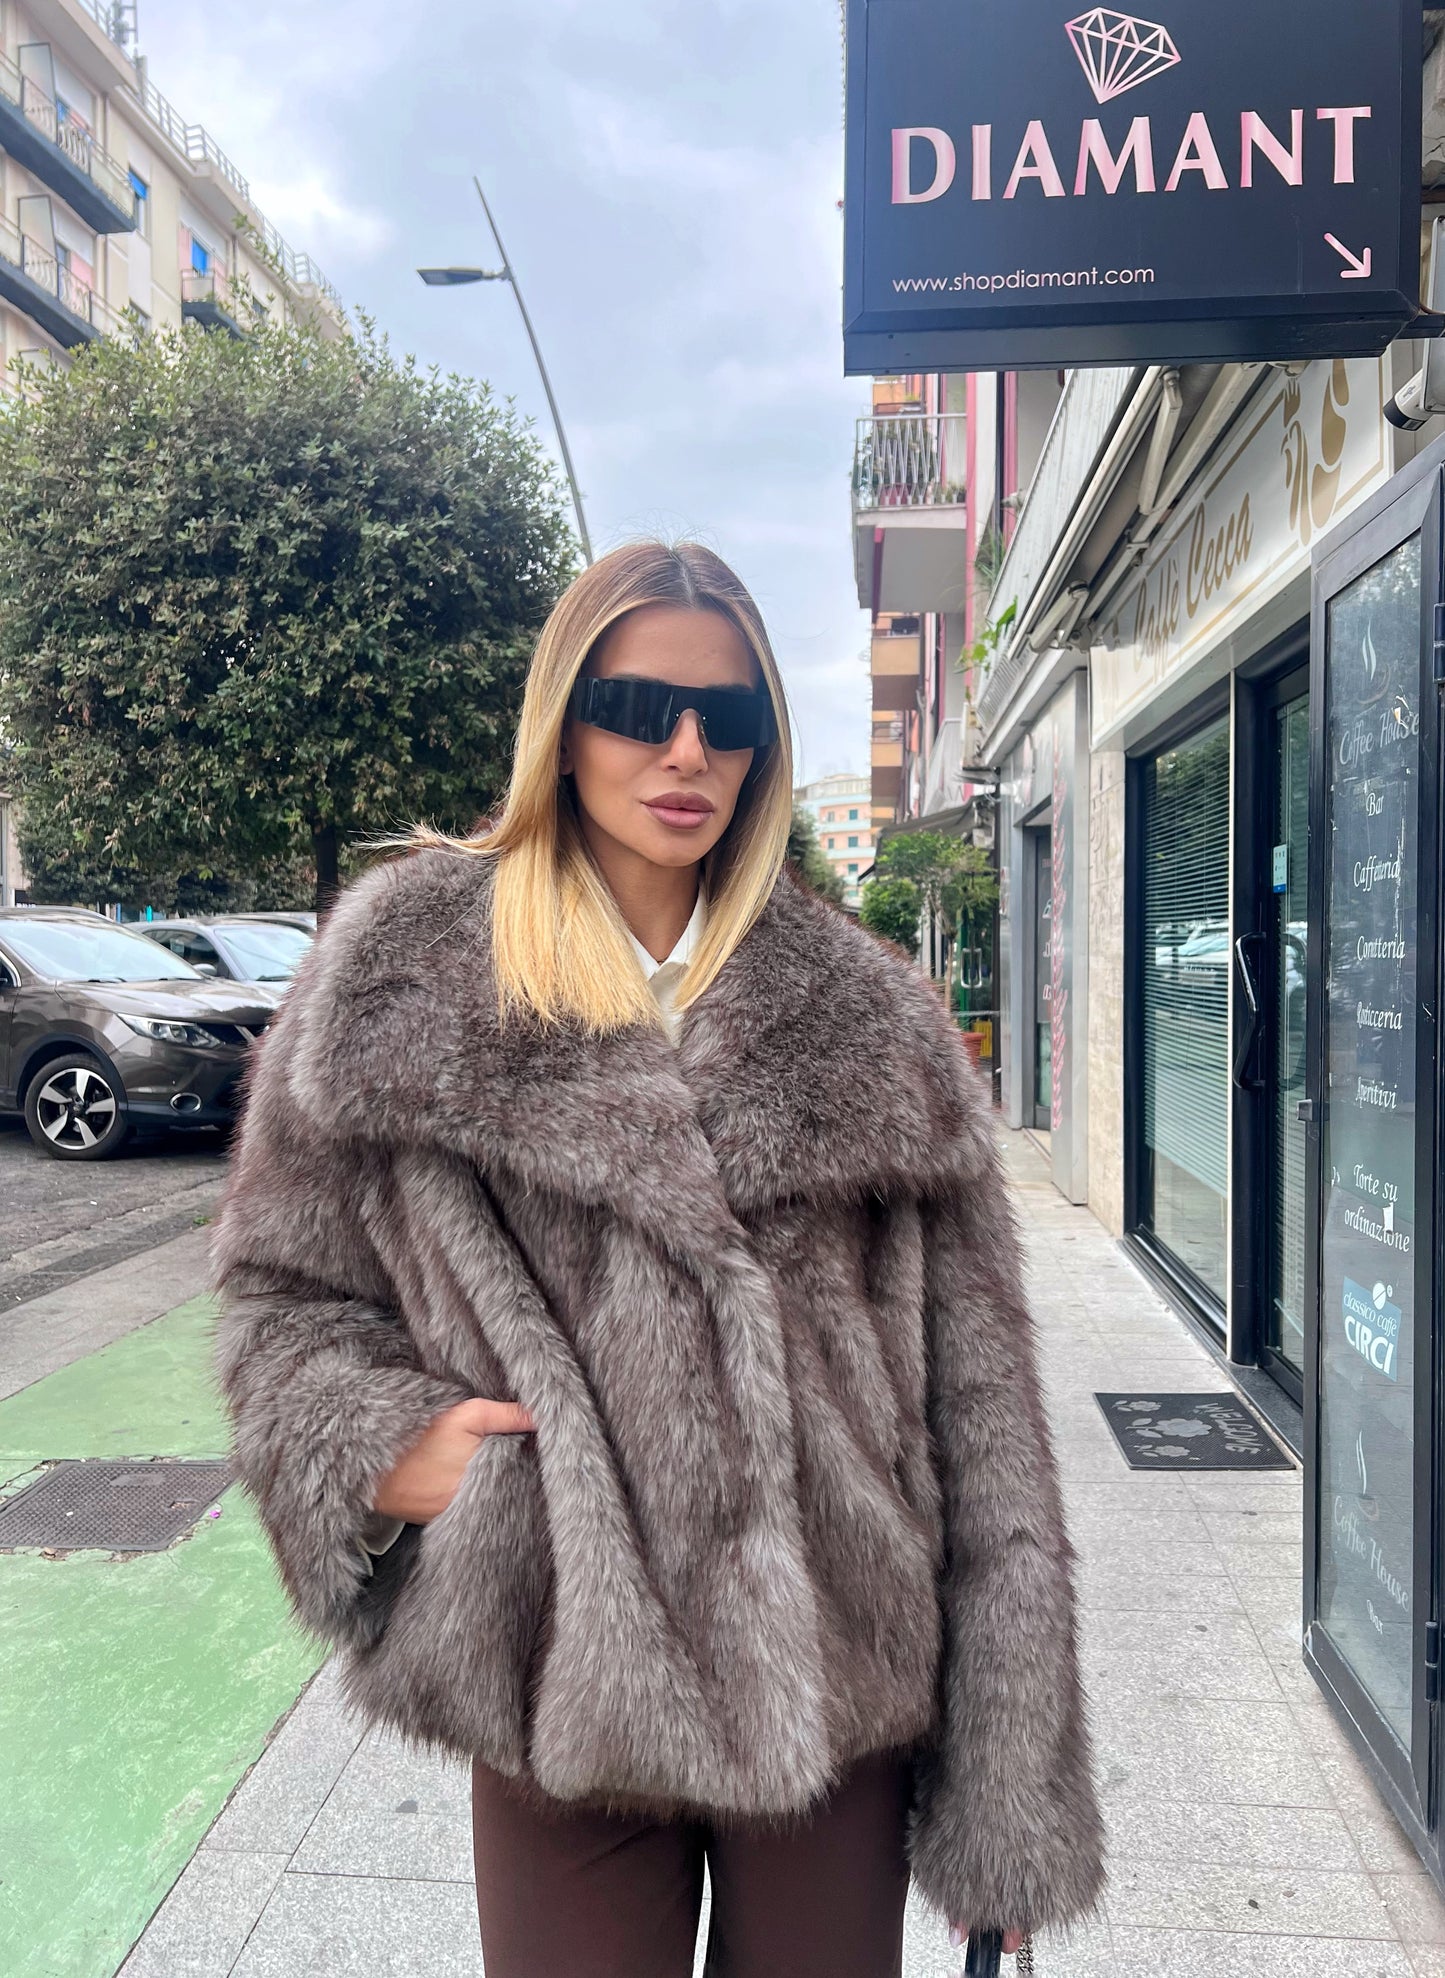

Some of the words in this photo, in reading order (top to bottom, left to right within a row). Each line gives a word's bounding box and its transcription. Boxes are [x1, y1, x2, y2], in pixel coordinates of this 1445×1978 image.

[890, 106, 1373, 205] DIAMANT
[892, 265, 1155, 294] www.shopdiamant.com
[1186, 493, 1255, 619] Cecca
[1366, 792, 1384, 817] Bar
[1356, 1001, 1403, 1030] Rosticceria
[1355, 1076, 1397, 1109] Aperitivi
[1353, 1164, 1380, 1195] Torte
[1382, 1182, 1398, 1202] su
[1344, 1205, 1410, 1253] ordinazione
[1343, 1292, 1376, 1323] classico
[1344, 1315, 1395, 1374] CIRCI
[1334, 1495, 1367, 1560] Coffee
[1370, 1537, 1409, 1612] House
